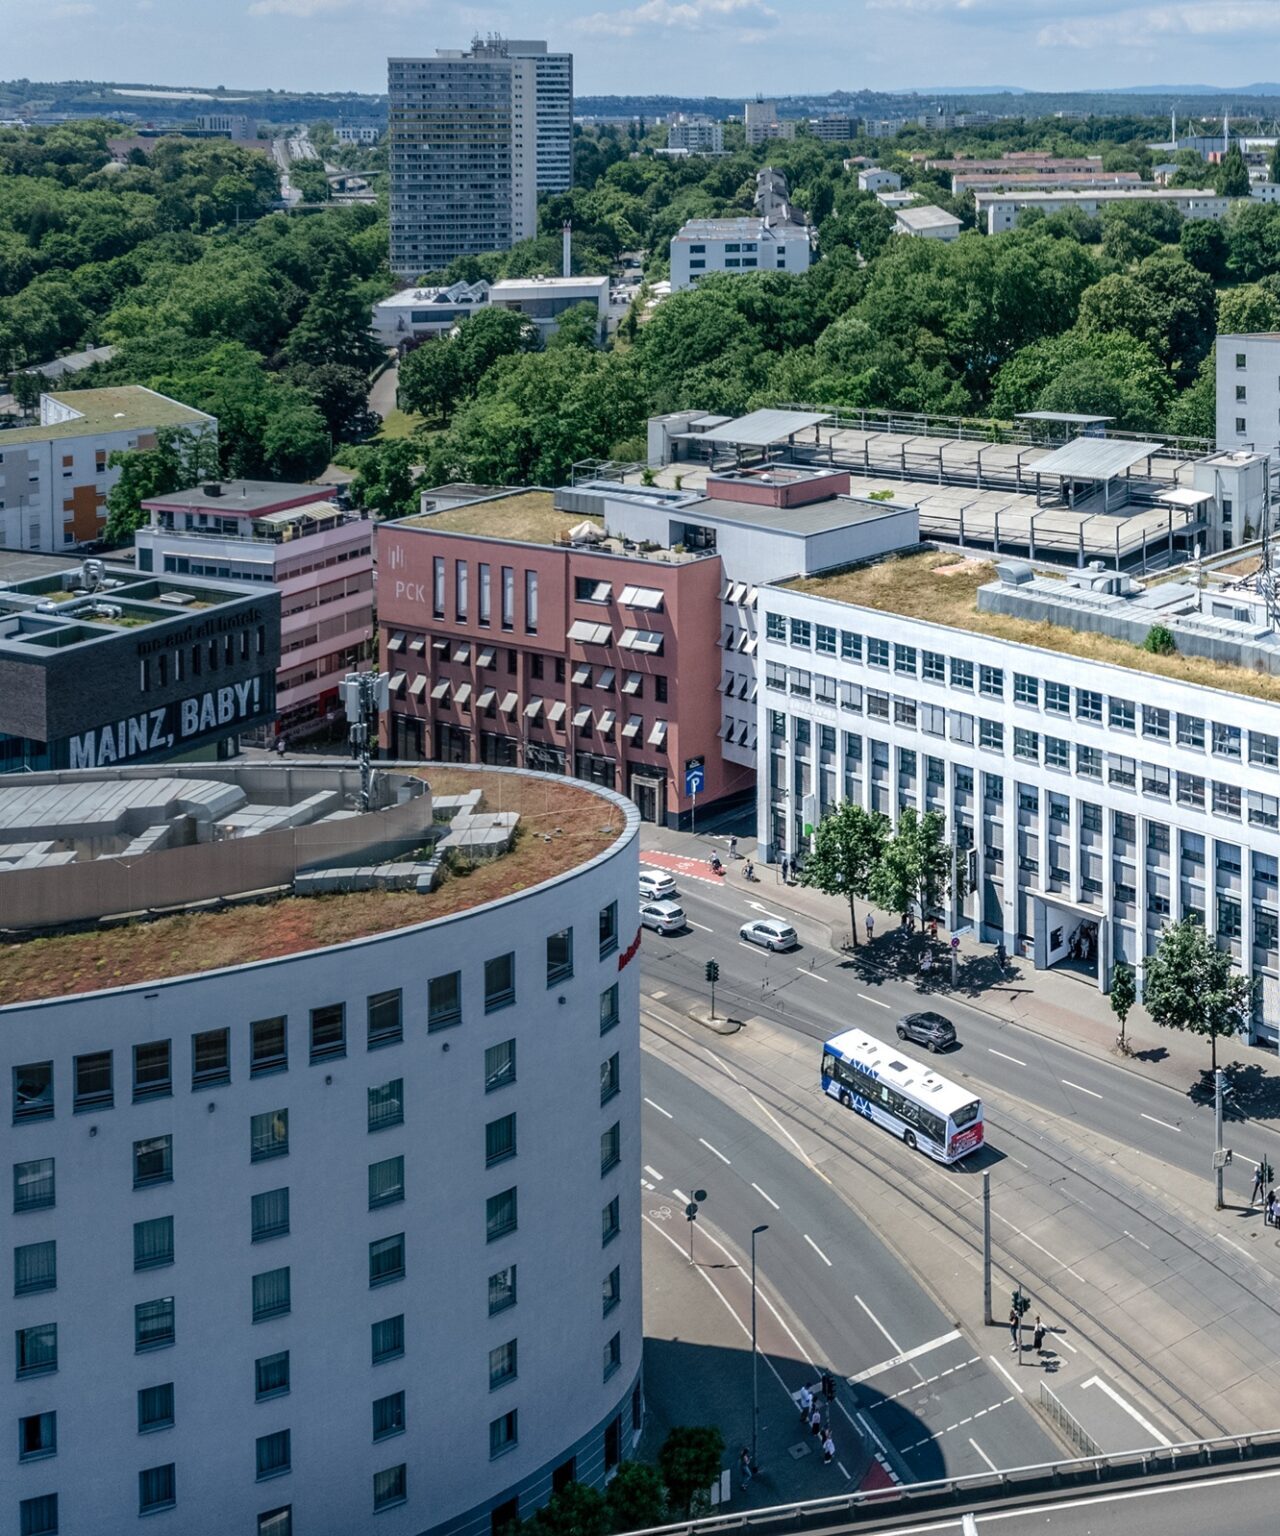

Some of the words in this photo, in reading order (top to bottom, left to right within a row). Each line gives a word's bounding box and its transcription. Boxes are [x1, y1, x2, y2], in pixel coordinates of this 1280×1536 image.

[396, 581, 425, 602] PCK
[166, 625, 192, 646] and
[198, 620, 213, 637] all
[218, 608, 262, 632] hotels
[69, 707, 174, 769] MAINZ,
[181, 677, 260, 737] BABY!
